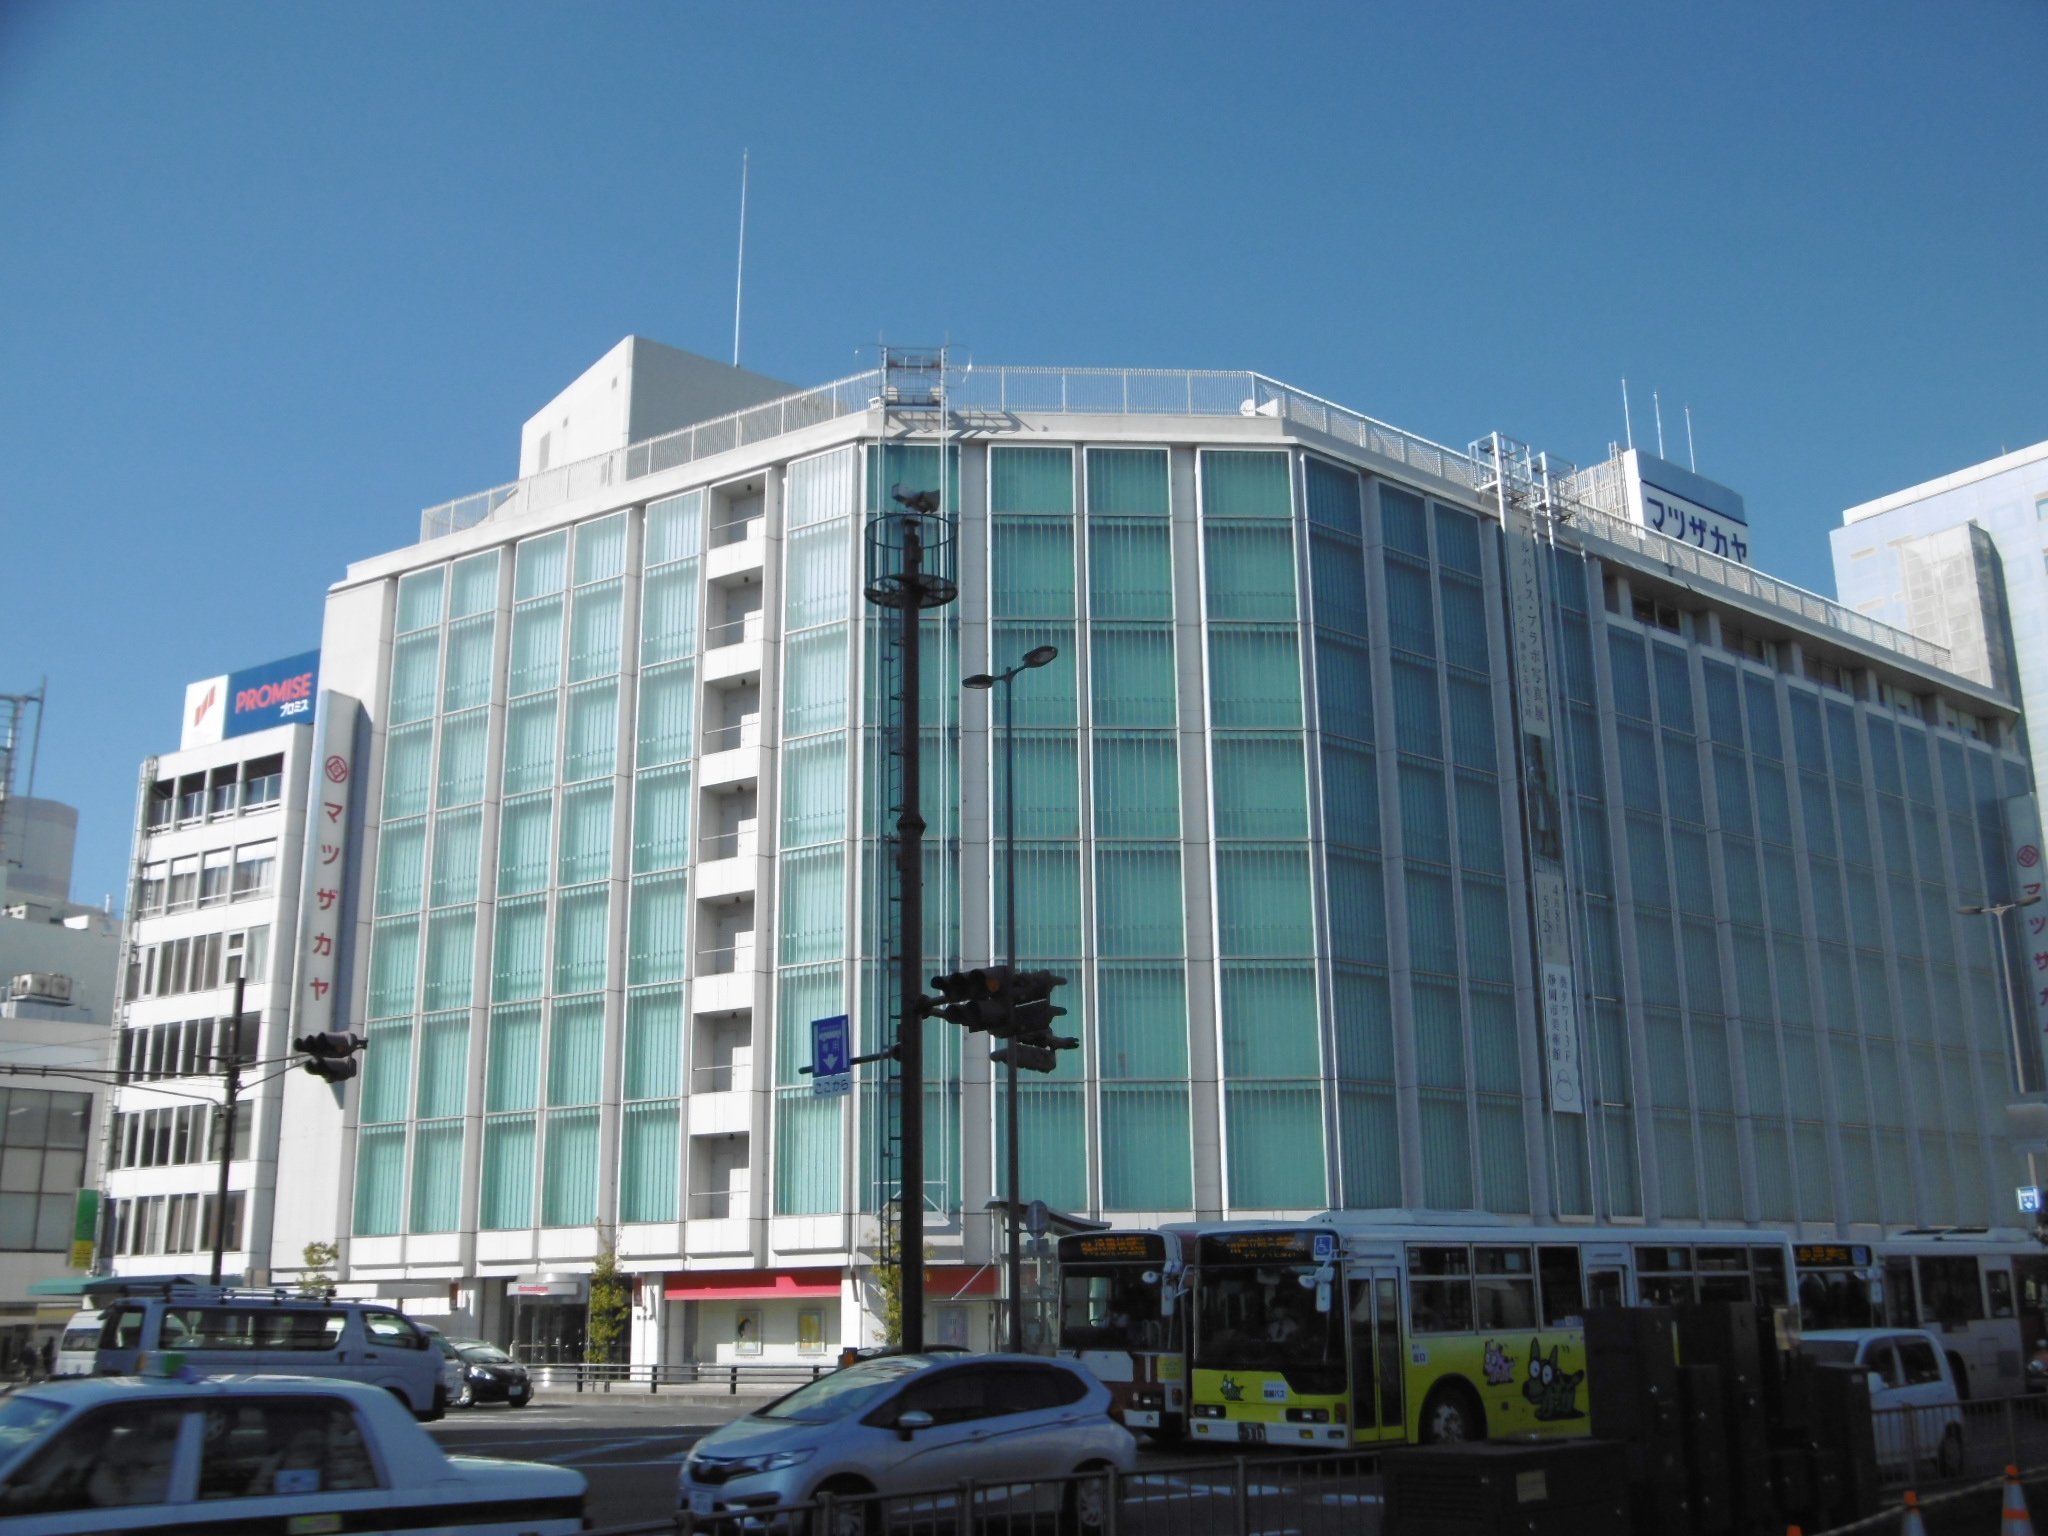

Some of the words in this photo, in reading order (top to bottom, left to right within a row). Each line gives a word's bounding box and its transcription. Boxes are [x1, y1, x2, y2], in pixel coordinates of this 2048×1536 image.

[1647, 497, 1747, 563] マツザカヤ
[235, 672, 312, 714] PROMISE
[280, 699, 308, 717] プロミス
[310, 801, 343, 1001] マツザカヤ
